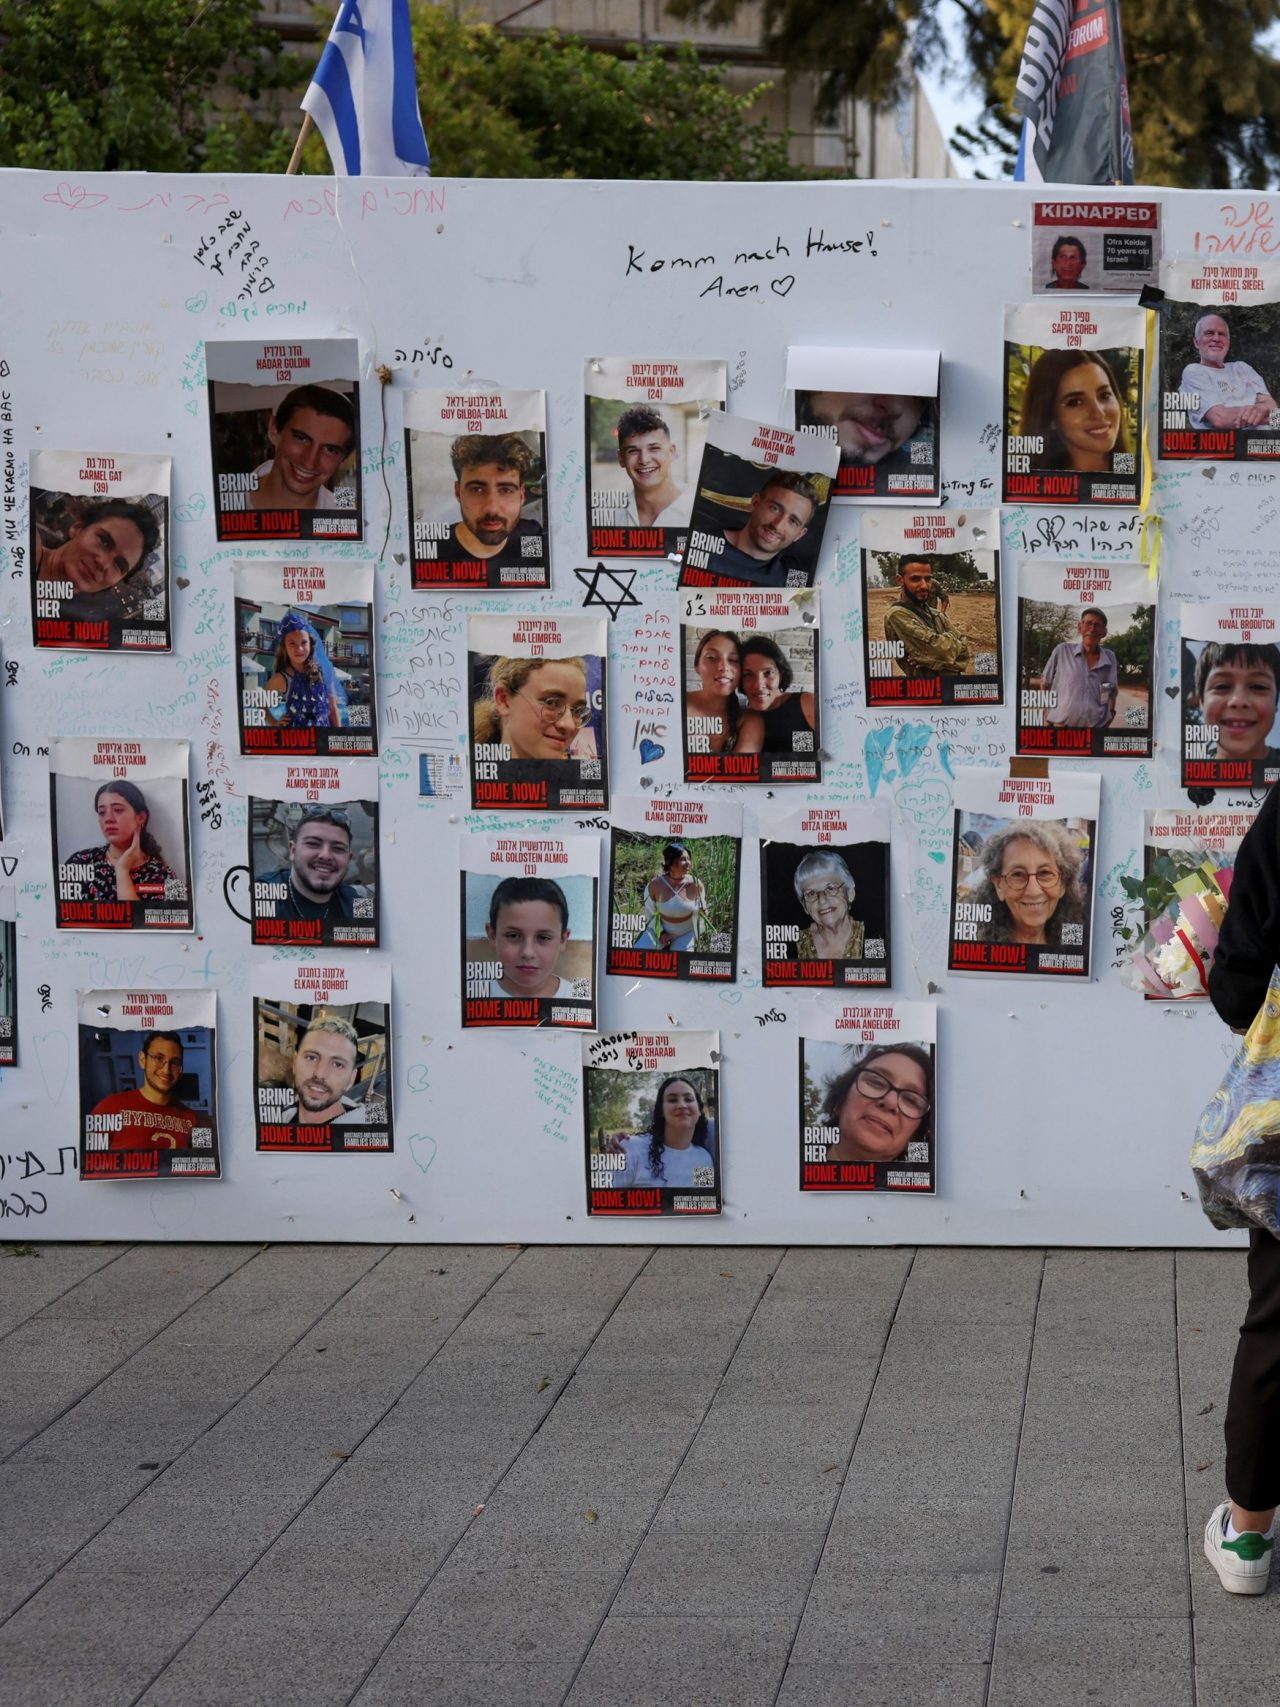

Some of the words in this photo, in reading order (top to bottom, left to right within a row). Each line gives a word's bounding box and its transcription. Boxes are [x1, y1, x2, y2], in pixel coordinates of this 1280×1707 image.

[1041, 204, 1151, 221] KIDNAPPED
[1220, 201, 1275, 229] שנה
[626, 245, 714, 276] Komm
[734, 236, 790, 264] nach
[806, 227, 878, 257] Hause!
[1117, 248, 1137, 256] years
[1106, 255, 1129, 263] Israeli
[699, 276, 759, 298] Amen
[1190, 278, 1212, 290] KEITH
[1212, 278, 1240, 291] SAMUEL
[1241, 279, 1264, 291] SIEGEL
[1051, 322, 1074, 335] SAPIR
[1074, 323, 1098, 335] COHEN
[1066, 334, 1082, 347] (29)
[255, 358, 283, 370] HADAR
[283, 357, 311, 369] GOLDIN
[276, 369, 292, 382] (32)
[626, 376, 656, 388] ELYAKIM
[656, 376, 685, 388] LIBMAN
[440, 408, 455, 420] GUY
[456, 408, 508, 420] GILBOA-DALAL
[751, 437, 785, 455] AVINATAN
[785, 444, 796, 458] OR
[78, 469, 107, 481] CARMEL
[108, 470, 122, 482] GAT
[903, 527, 932, 539] NIMROD
[932, 527, 956, 539] COHEN
[282, 578, 296, 590] ELA
[297, 578, 326, 590] ELYAKIM
[1062, 579, 1082, 591] ODED
[1082, 579, 1112, 591] LIFSHITZ
[709, 605, 730, 616] HAGIT
[731, 605, 759, 616] REFAELI
[759, 605, 790, 616] MISHKIN
[1217, 619, 1239, 630] YUVAL
[1240, 619, 1276, 630] BRODUTCH
[512, 632, 527, 644] MIA
[527, 632, 562, 644] LEIMBERG
[92, 754, 117, 766] DAFNA
[117, 754, 147, 766] ELYAKIM
[285, 778, 309, 789] ALMOG
[309, 778, 327, 790] MEIR
[327, 779, 341, 790] JAN
[998, 791, 1016, 803] JUDY
[1016, 792, 1055, 805] WEINSTEIN
[644, 810, 665, 822] ILANA
[801, 820, 821, 831] DITZA
[821, 820, 848, 831] HEIMAN
[490, 851, 503, 863] GAL
[505, 851, 543, 864] GOLDSTEIN
[544, 852, 569, 864] ALMOG
[293, 978, 321, 990] ELKANA
[321, 979, 349, 991] BOHBOT
[122, 1005, 144, 1016] TAMIR
[144, 1005, 174, 1016] NIMRODI
[834, 1018, 861, 1030] CARINA
[862, 1019, 900, 1030] ANGELBERT
[860, 1030, 875, 1042] (51)
[644, 1047, 676, 1058] SHARABI
[804, 1126, 840, 1144] BRING
[804, 1145, 827, 1162] HER
[804, 1164, 838, 1183] HOME
[840, 1163, 875, 1183] NOW!
[887, 1177, 911, 1186] FAMILIES
[911, 1177, 930, 1187] FORUM
